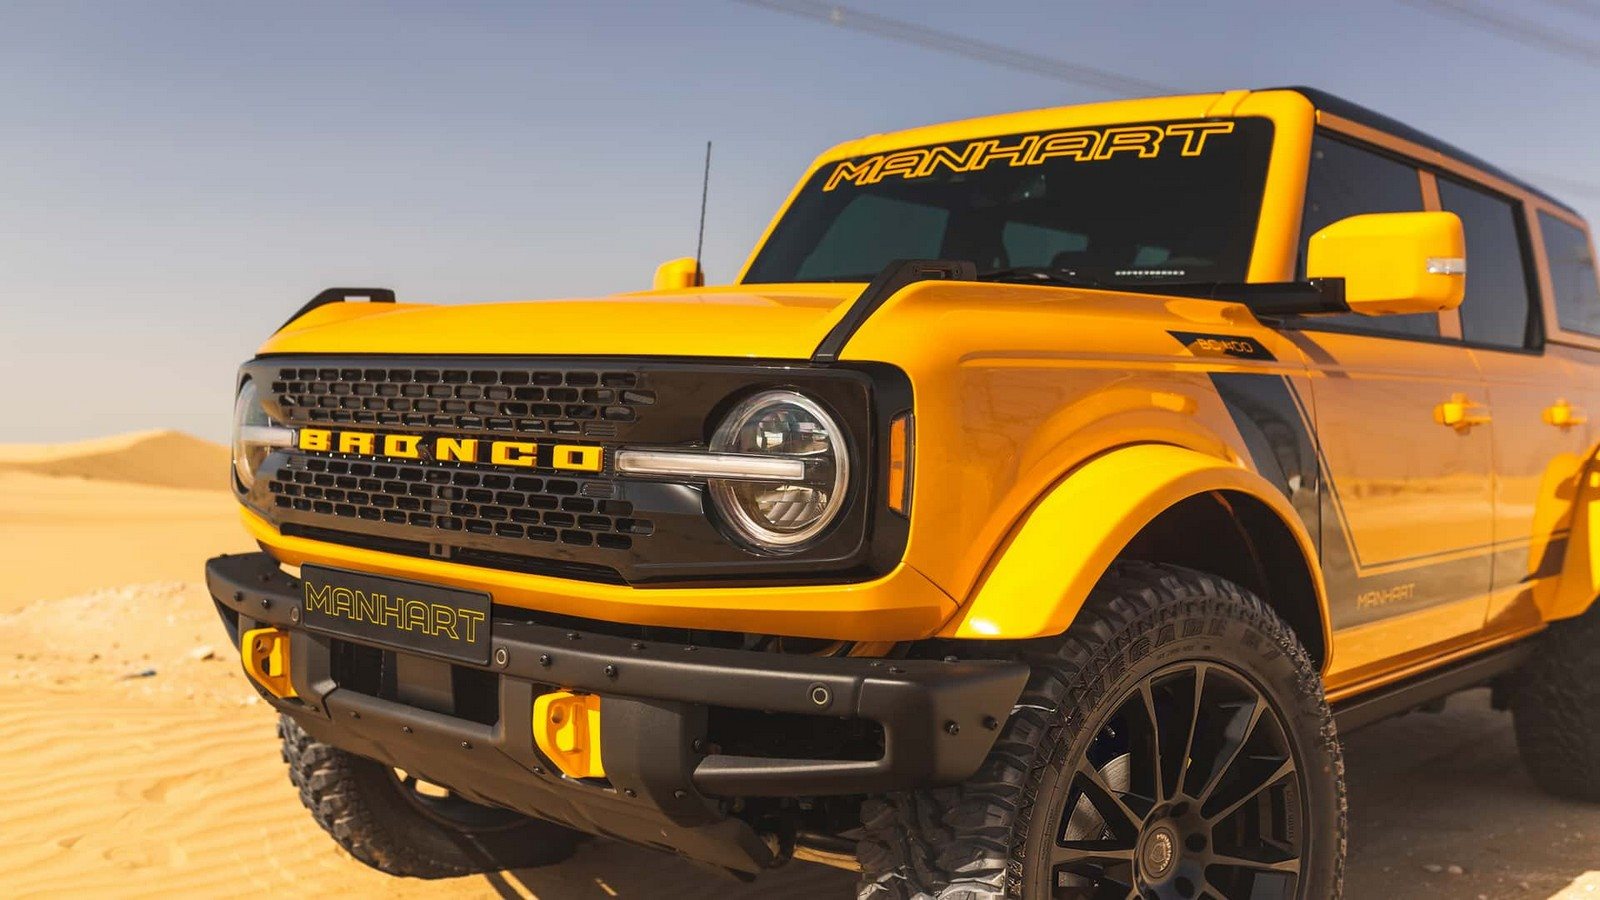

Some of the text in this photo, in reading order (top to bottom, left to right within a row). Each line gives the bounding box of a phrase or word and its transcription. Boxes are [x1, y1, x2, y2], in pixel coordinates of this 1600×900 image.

[823, 122, 1234, 191] MANHART
[300, 428, 604, 472] BRONCO
[305, 581, 485, 643] MANHART
[1356, 582, 1416, 610] MANHART
